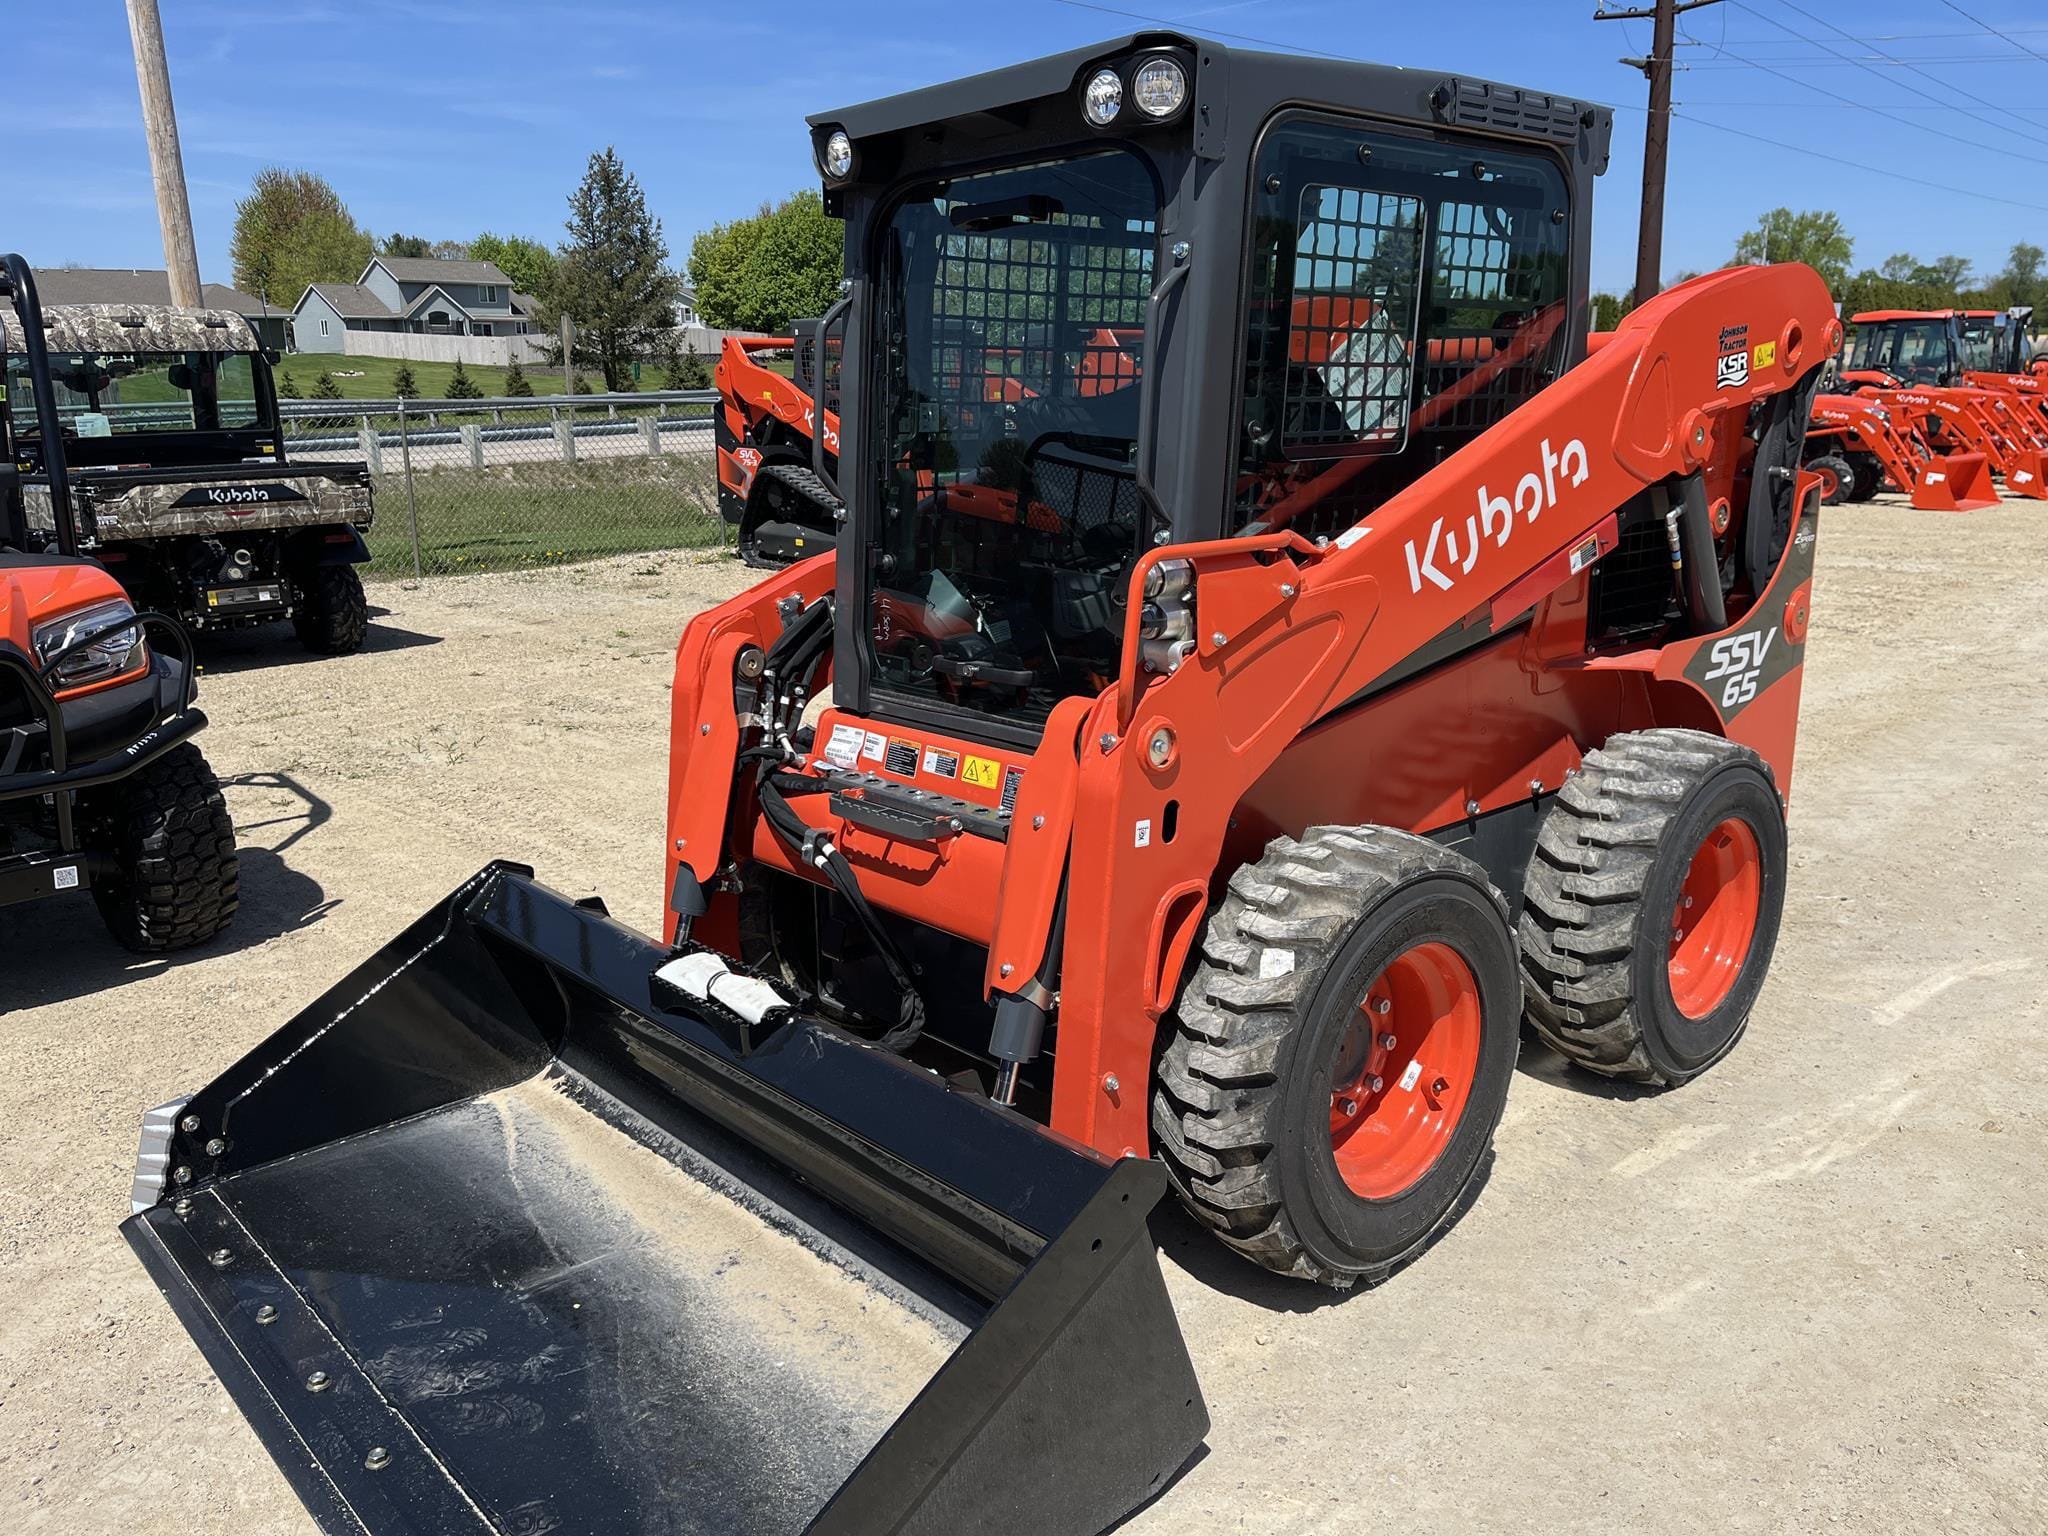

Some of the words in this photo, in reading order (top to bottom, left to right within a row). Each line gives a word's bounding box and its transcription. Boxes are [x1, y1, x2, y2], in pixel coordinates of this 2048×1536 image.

[1719, 325, 1748, 340] JOHNSON
[1720, 338, 1747, 353] TRACTOR
[1718, 352, 1748, 376] KSR
[1896, 394, 1930, 405] Kubota
[739, 450, 756, 459] SVL
[208, 487, 269, 503] Kubota
[1404, 438, 1589, 594] Kubota
[1704, 626, 1778, 681] SSV
[1722, 669, 1761, 708] 65
